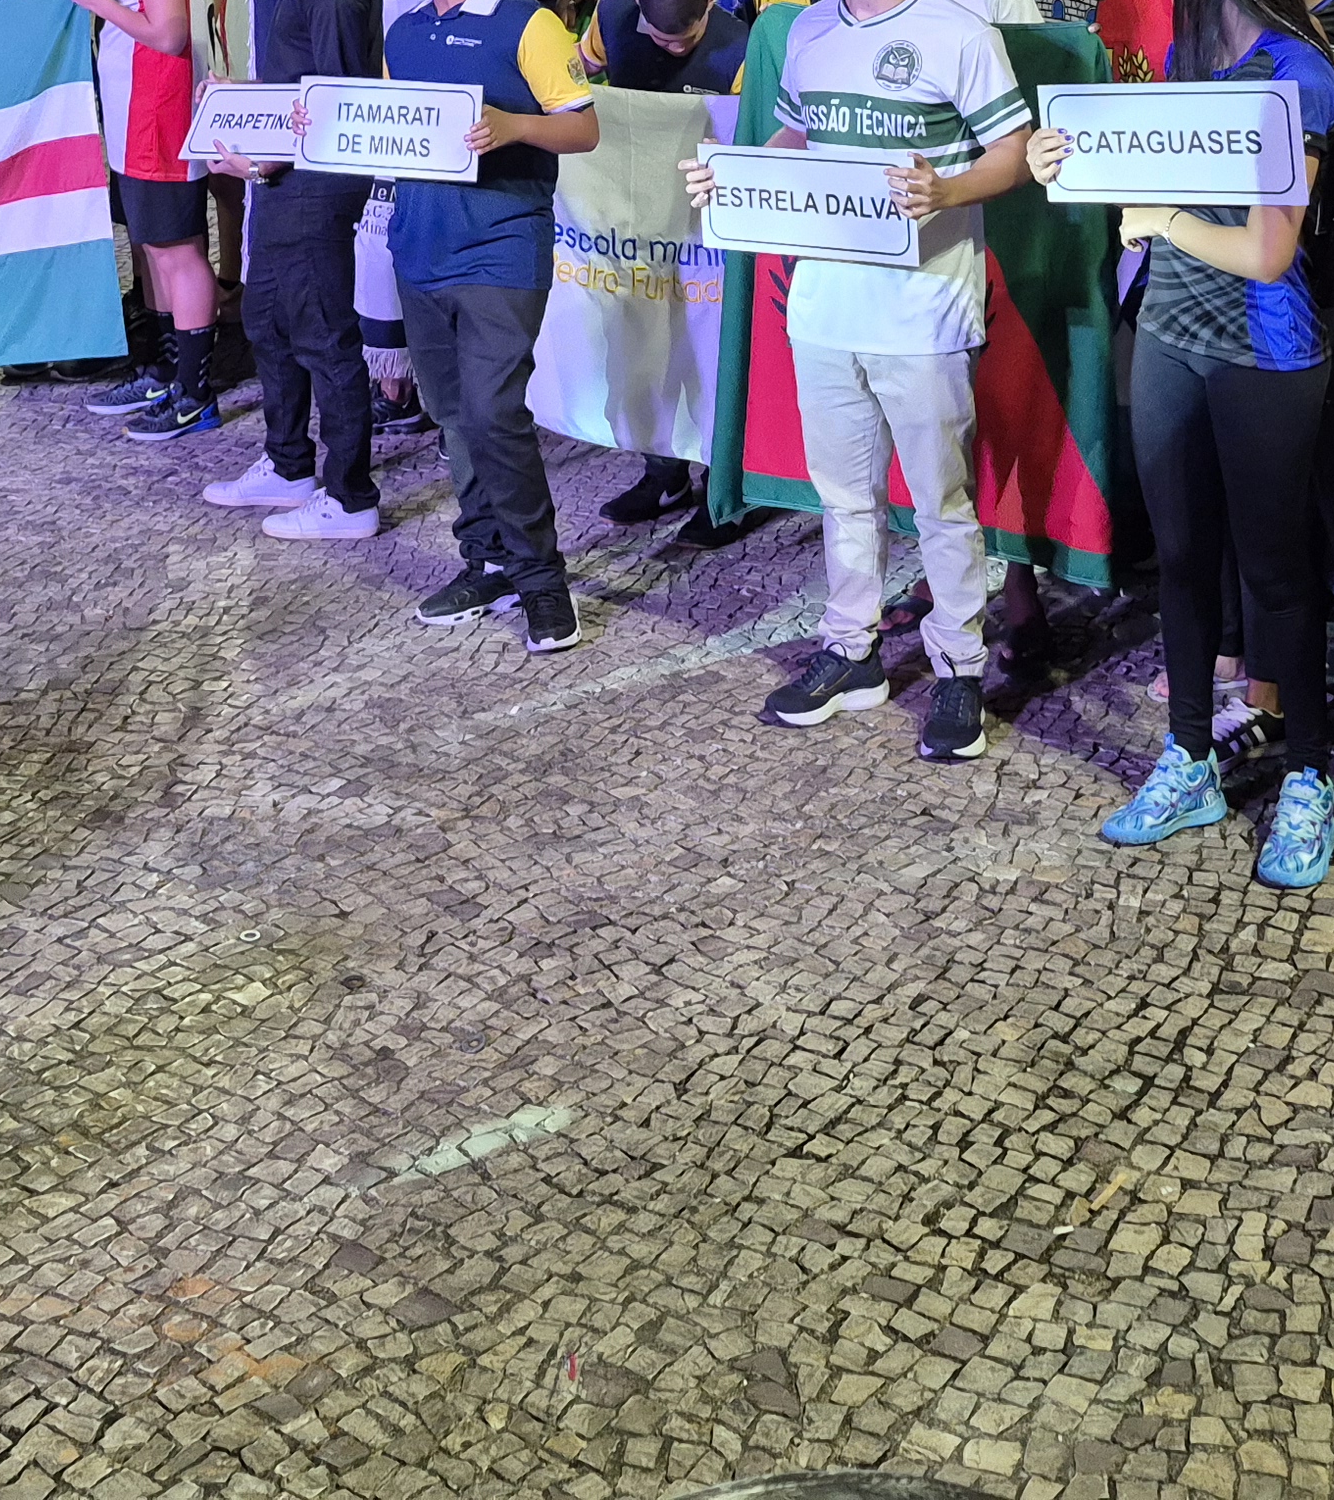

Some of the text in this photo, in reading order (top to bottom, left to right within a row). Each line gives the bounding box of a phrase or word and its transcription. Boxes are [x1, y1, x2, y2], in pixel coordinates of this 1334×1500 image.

[337, 102, 440, 126] ITAMARATI
[802, 99, 927, 138] ISSÃO TÉCNICA
[338, 133, 430, 157] DE MINAS
[1076, 129, 1263, 155] CATAGUASES
[717, 185, 902, 221] ESTRELA DALVA
[554, 223, 725, 267] escola muni
[554, 252, 619, 294] edro
